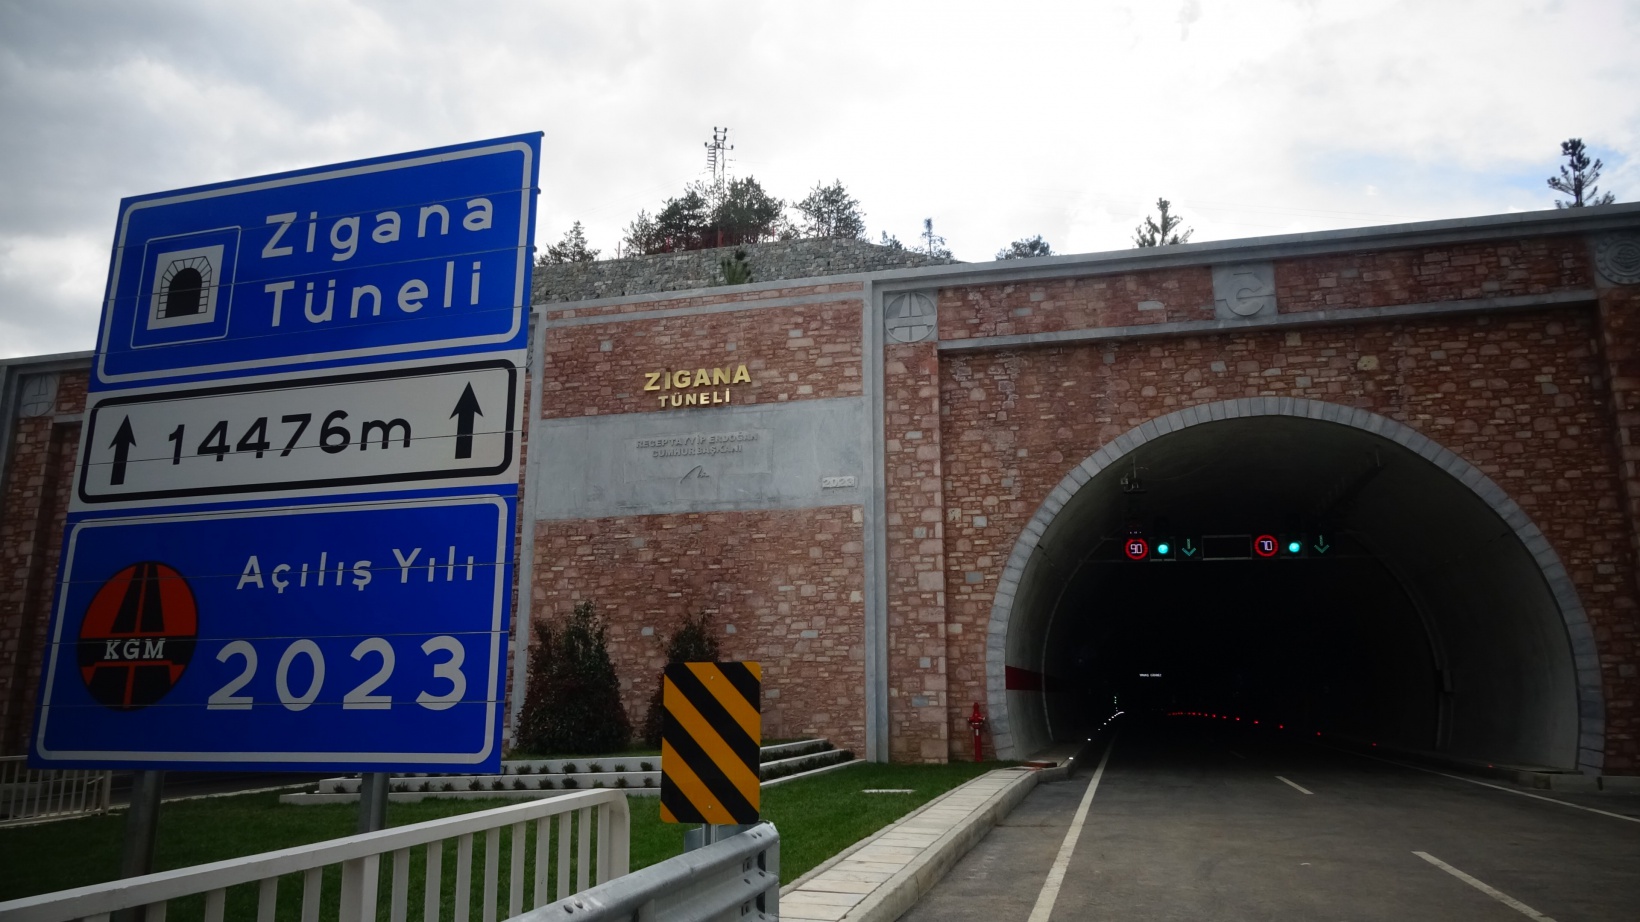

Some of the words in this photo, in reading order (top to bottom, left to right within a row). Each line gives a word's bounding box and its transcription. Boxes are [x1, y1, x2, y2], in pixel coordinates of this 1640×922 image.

[261, 197, 493, 262] Zigana
[264, 260, 481, 327] Tüneli
[658, 388, 730, 408] TÜNELİ
[168, 409, 412, 465] 14476m
[709, 431, 759, 445] ERDOĞAN
[1130, 543, 1143, 554] 90
[1260, 540, 1273, 551] 70
[236, 551, 372, 594] Açılış
[392, 545, 475, 584] Yılı
[104, 637, 166, 660] KGM
[206, 635, 467, 711] 2023
